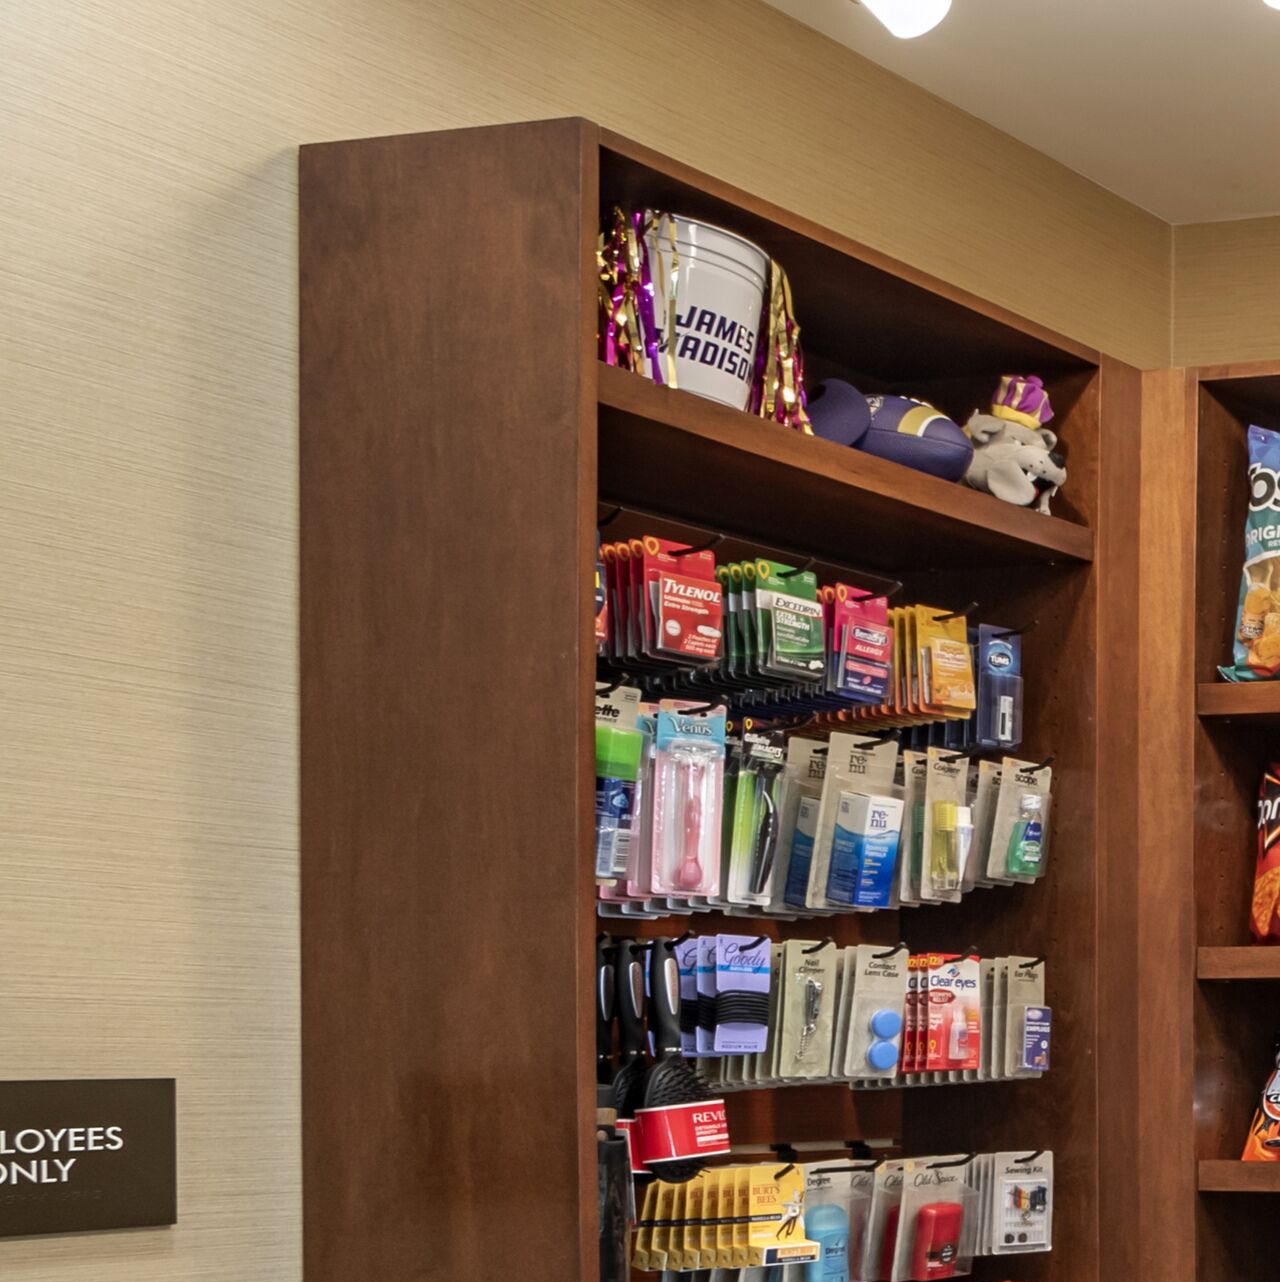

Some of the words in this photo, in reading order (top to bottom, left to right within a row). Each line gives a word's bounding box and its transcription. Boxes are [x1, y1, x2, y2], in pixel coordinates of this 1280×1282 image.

[676, 305, 754, 355] JAMES
[663, 578, 720, 603] TYLENOL
[669, 716, 713, 736] Venus
[724, 942, 766, 972] Goody
[930, 975, 953, 987] Clear
[955, 977, 976, 989] eyes
[0, 1159, 76, 1185] NLY
[913, 1173, 932, 1187] Old
[1005, 1166, 1032, 1174] Sewing
[757, 1194, 777, 1204] BEES
